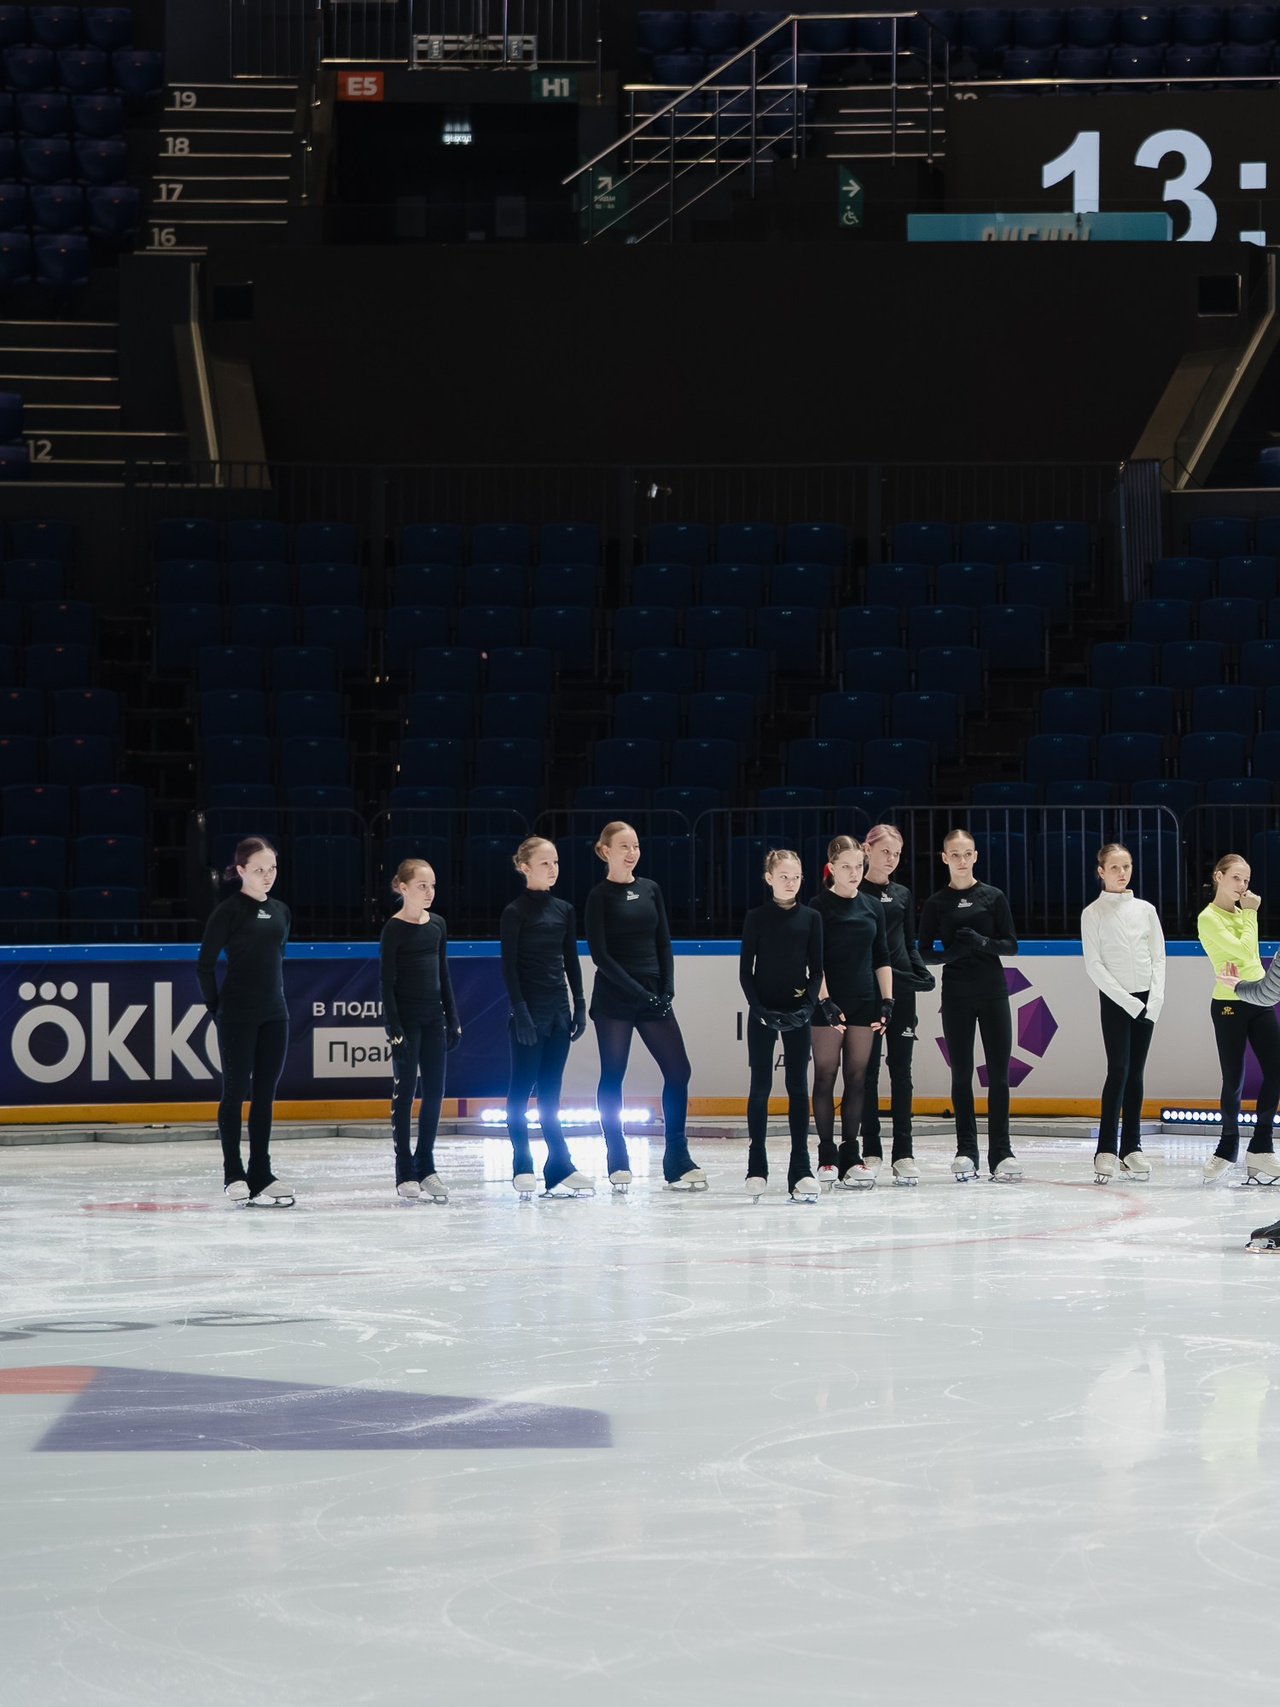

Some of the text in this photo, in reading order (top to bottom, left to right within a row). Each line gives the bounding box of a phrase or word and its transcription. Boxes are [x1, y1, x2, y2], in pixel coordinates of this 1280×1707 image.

[347, 76, 378, 96] E5
[541, 77, 570, 98] H1
[172, 91, 198, 109] 19
[165, 137, 191, 155] 18
[158, 183, 184, 201] 17
[151, 228, 177, 247] 16
[26, 440, 53, 460] 12
[313, 1002, 326, 1017] в
